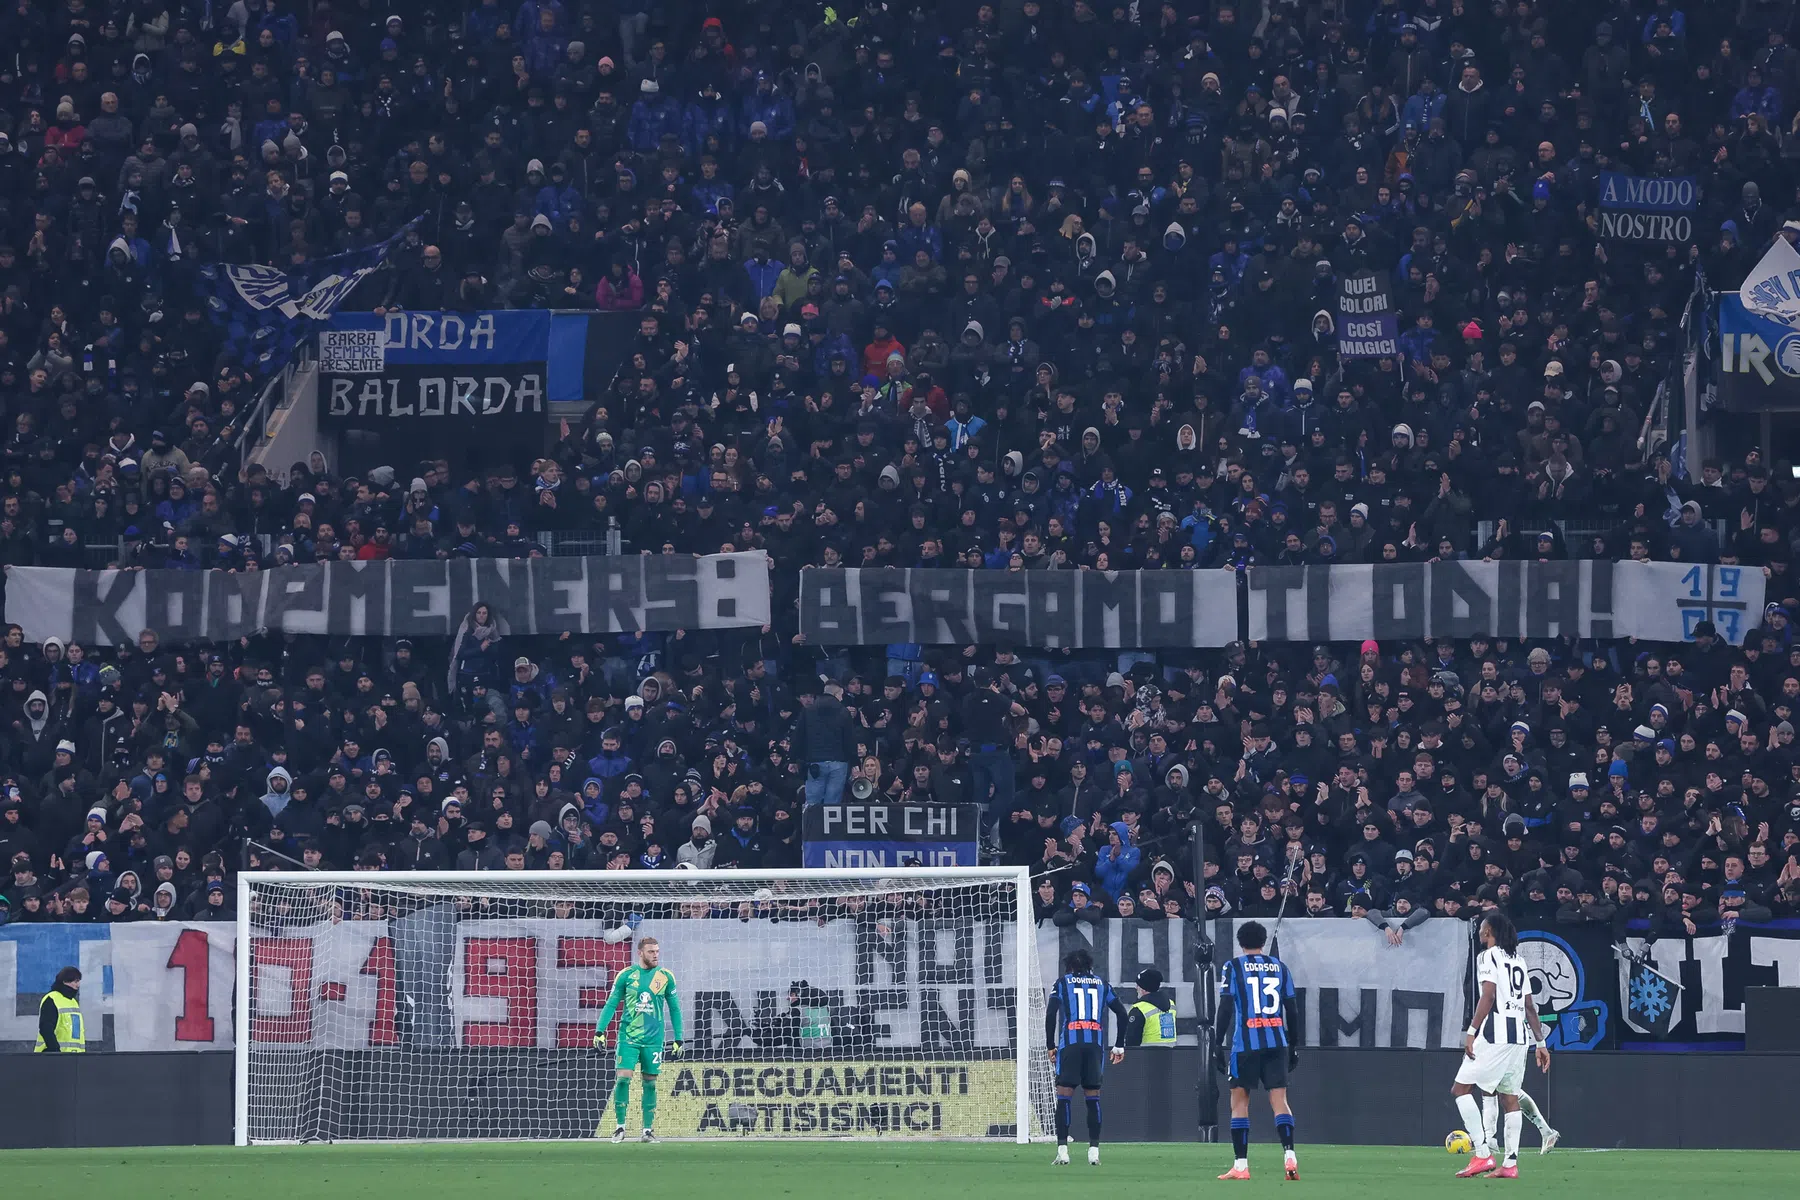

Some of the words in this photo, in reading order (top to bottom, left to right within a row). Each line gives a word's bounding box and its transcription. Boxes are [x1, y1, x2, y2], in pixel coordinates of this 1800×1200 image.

[1603, 176, 1618, 202] A
[1625, 178, 1692, 205] MODO
[1600, 212, 1692, 241] NOSTRO
[1344, 276, 1377, 295] QUEI
[1340, 293, 1388, 314] COLORI
[328, 332, 376, 346] BARBA
[383, 312, 496, 350] ORDA
[1347, 320, 1382, 338] COSÌ
[323, 345, 380, 359] SEMPRE
[1340, 339, 1396, 354] MAGICI
[321, 358, 383, 371] PRESENTE
[329, 374, 542, 417] BALORDA
[801, 567, 1194, 648] BERGAMO
[1250, 564, 1330, 641] TI
[1372, 559, 1614, 640] ODIA!
[823, 806, 888, 834] PER
[904, 807, 957, 835] CHI
[1067, 976, 1103, 986] LOOKMAN
[1244, 961, 1280, 972] ÉDERSON
[1504, 962, 1525, 1000] 19
[1073, 987, 1098, 1020] 11
[1246, 976, 1280, 1015] 13
[670, 1066, 968, 1098] ADEGUAMENTI
